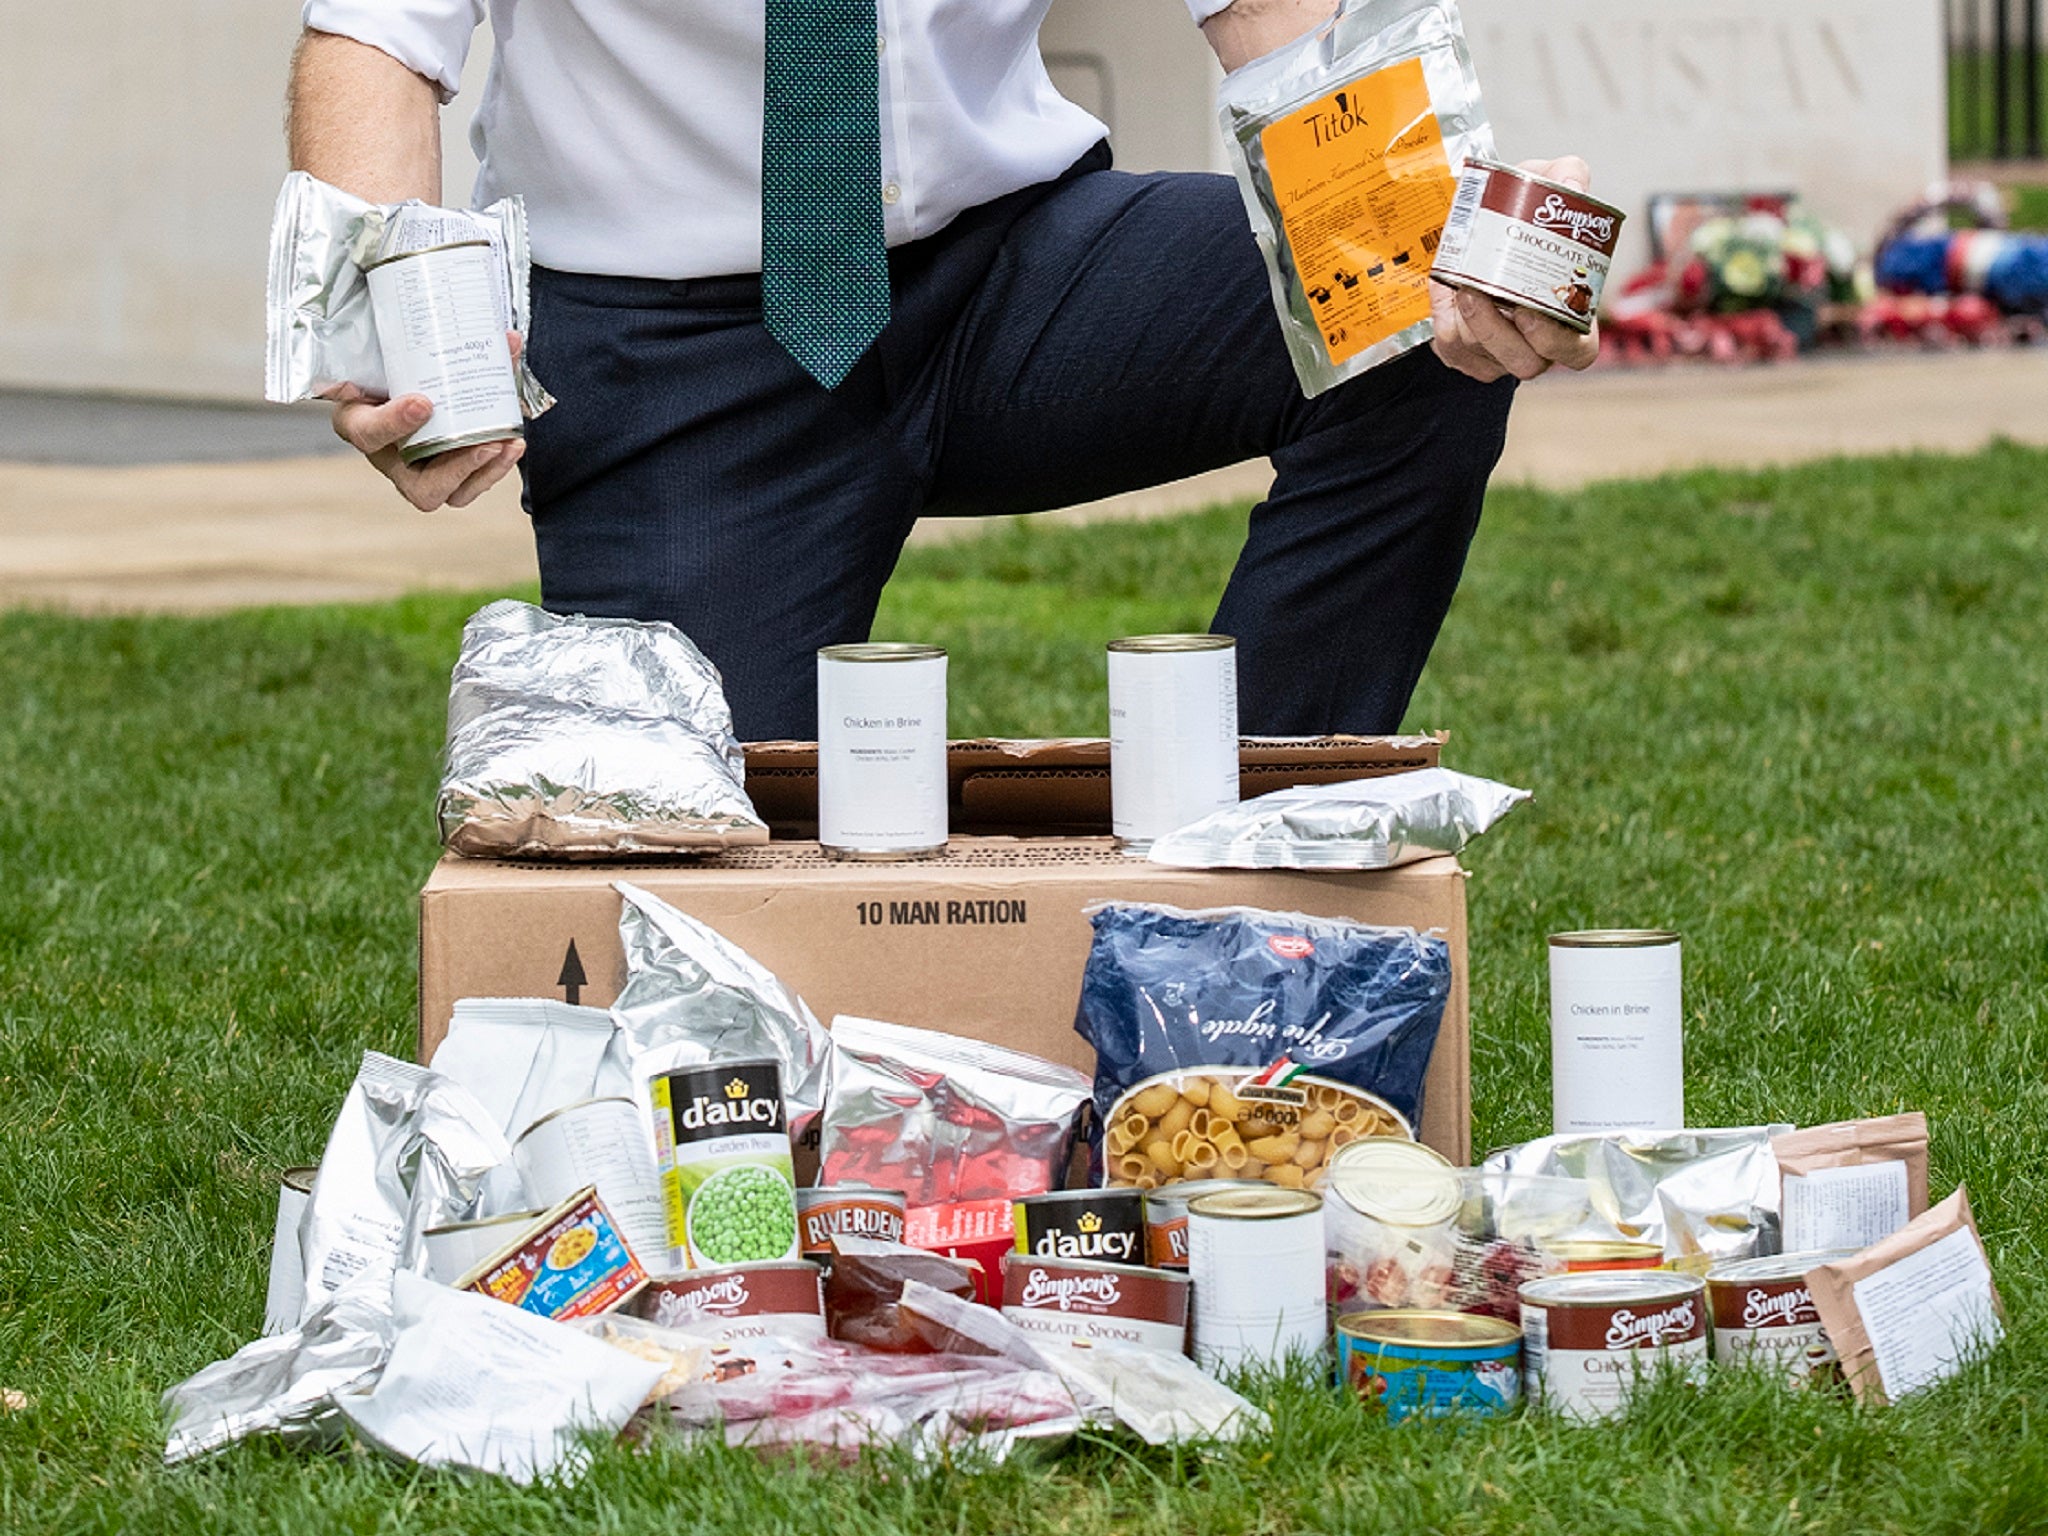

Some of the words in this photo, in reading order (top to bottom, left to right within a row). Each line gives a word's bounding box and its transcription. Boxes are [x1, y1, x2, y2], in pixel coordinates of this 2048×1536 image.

[1303, 93, 1368, 148] Titok
[1506, 224, 1583, 265] CHOCOLATE
[844, 716, 882, 729] Chicken
[884, 717, 895, 729] in
[897, 716, 922, 729] Brine
[857, 902, 882, 925] 10
[890, 901, 940, 925] MAN
[947, 900, 1027, 924] RATION
[1200, 999, 1276, 1043] rigate
[1570, 1003, 1609, 1016] Chicken
[1611, 1004, 1621, 1016] in
[1625, 1003, 1650, 1016] Brine
[682, 1097, 779, 1129] d'aucy
[708, 1137, 749, 1154] Garden
[1036, 1228, 1135, 1258] d'aucy
[656, 1275, 750, 1327] Simpson's
[1022, 1268, 1121, 1311] Simpson's
[1009, 1312, 1080, 1336] CHOCOLATE
[1087, 1319, 1144, 1342] SPONGE
[1605, 1300, 1696, 1350] Simpson's
